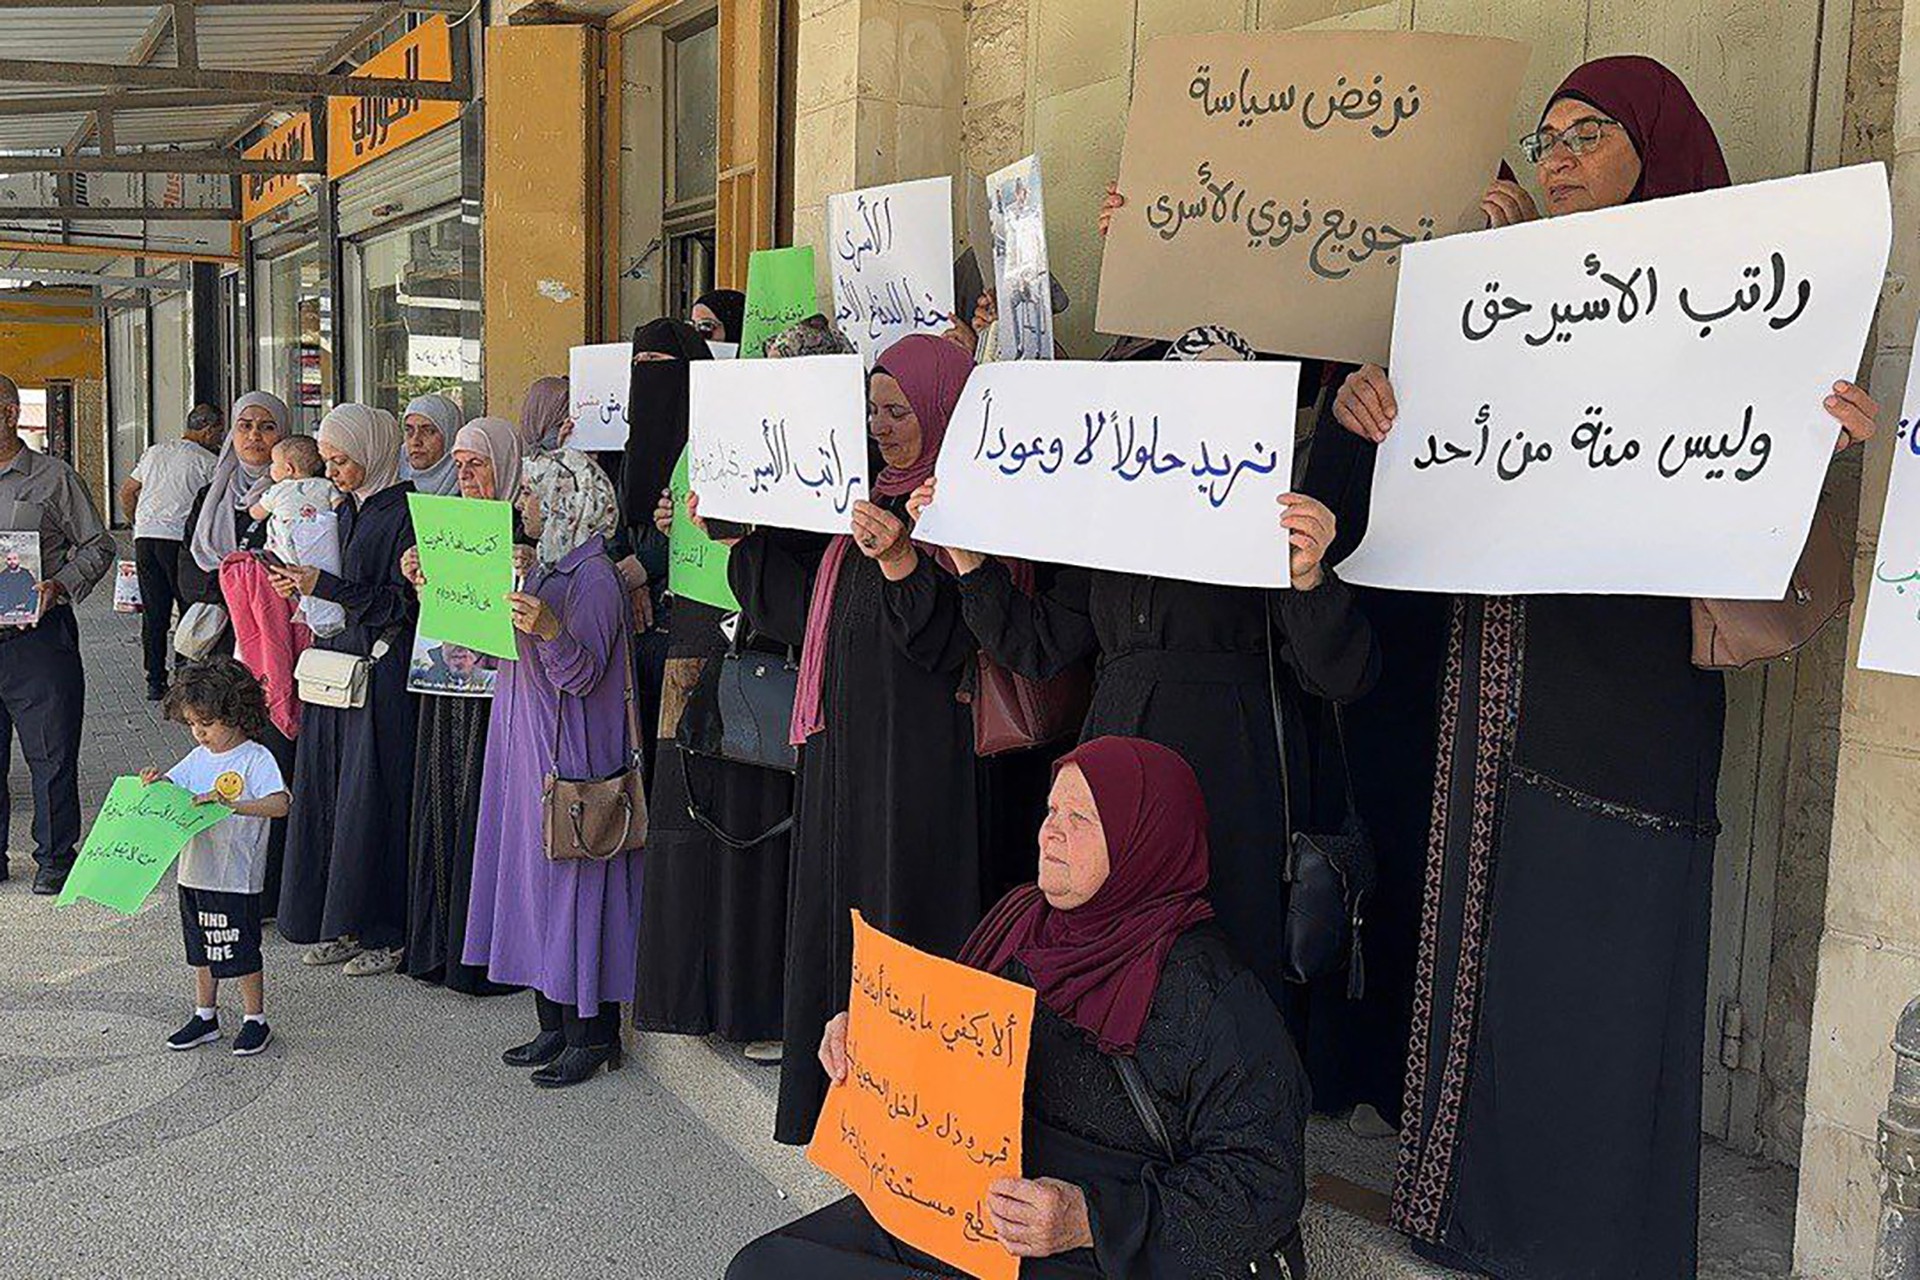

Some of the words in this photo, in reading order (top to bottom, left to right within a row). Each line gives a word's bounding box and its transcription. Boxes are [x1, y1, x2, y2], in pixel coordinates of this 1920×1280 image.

[1188, 65, 1296, 128] سياسة
[1302, 75, 1420, 139] نرفض
[1146, 161, 1245, 240] الأسرى
[1246, 198, 1310, 248] ذوي
[1308, 217, 1434, 280] تجويع
[1461, 283, 1531, 340] حق
[1525, 253, 1658, 345] الأسير
[1679, 252, 1811, 338] راتب
[1073, 410, 1107, 465] لا
[1414, 404, 1490, 470] أحد
[1499, 429, 1553, 480] من
[1571, 406, 1640, 468] منة
[1658, 406, 1772, 481] وليس
[1191, 440, 1278, 508] نريد
[198, 911, 228, 928] FIND
[204, 928, 240, 944] YOUR
[940, 1013, 989, 1058] يكفي
